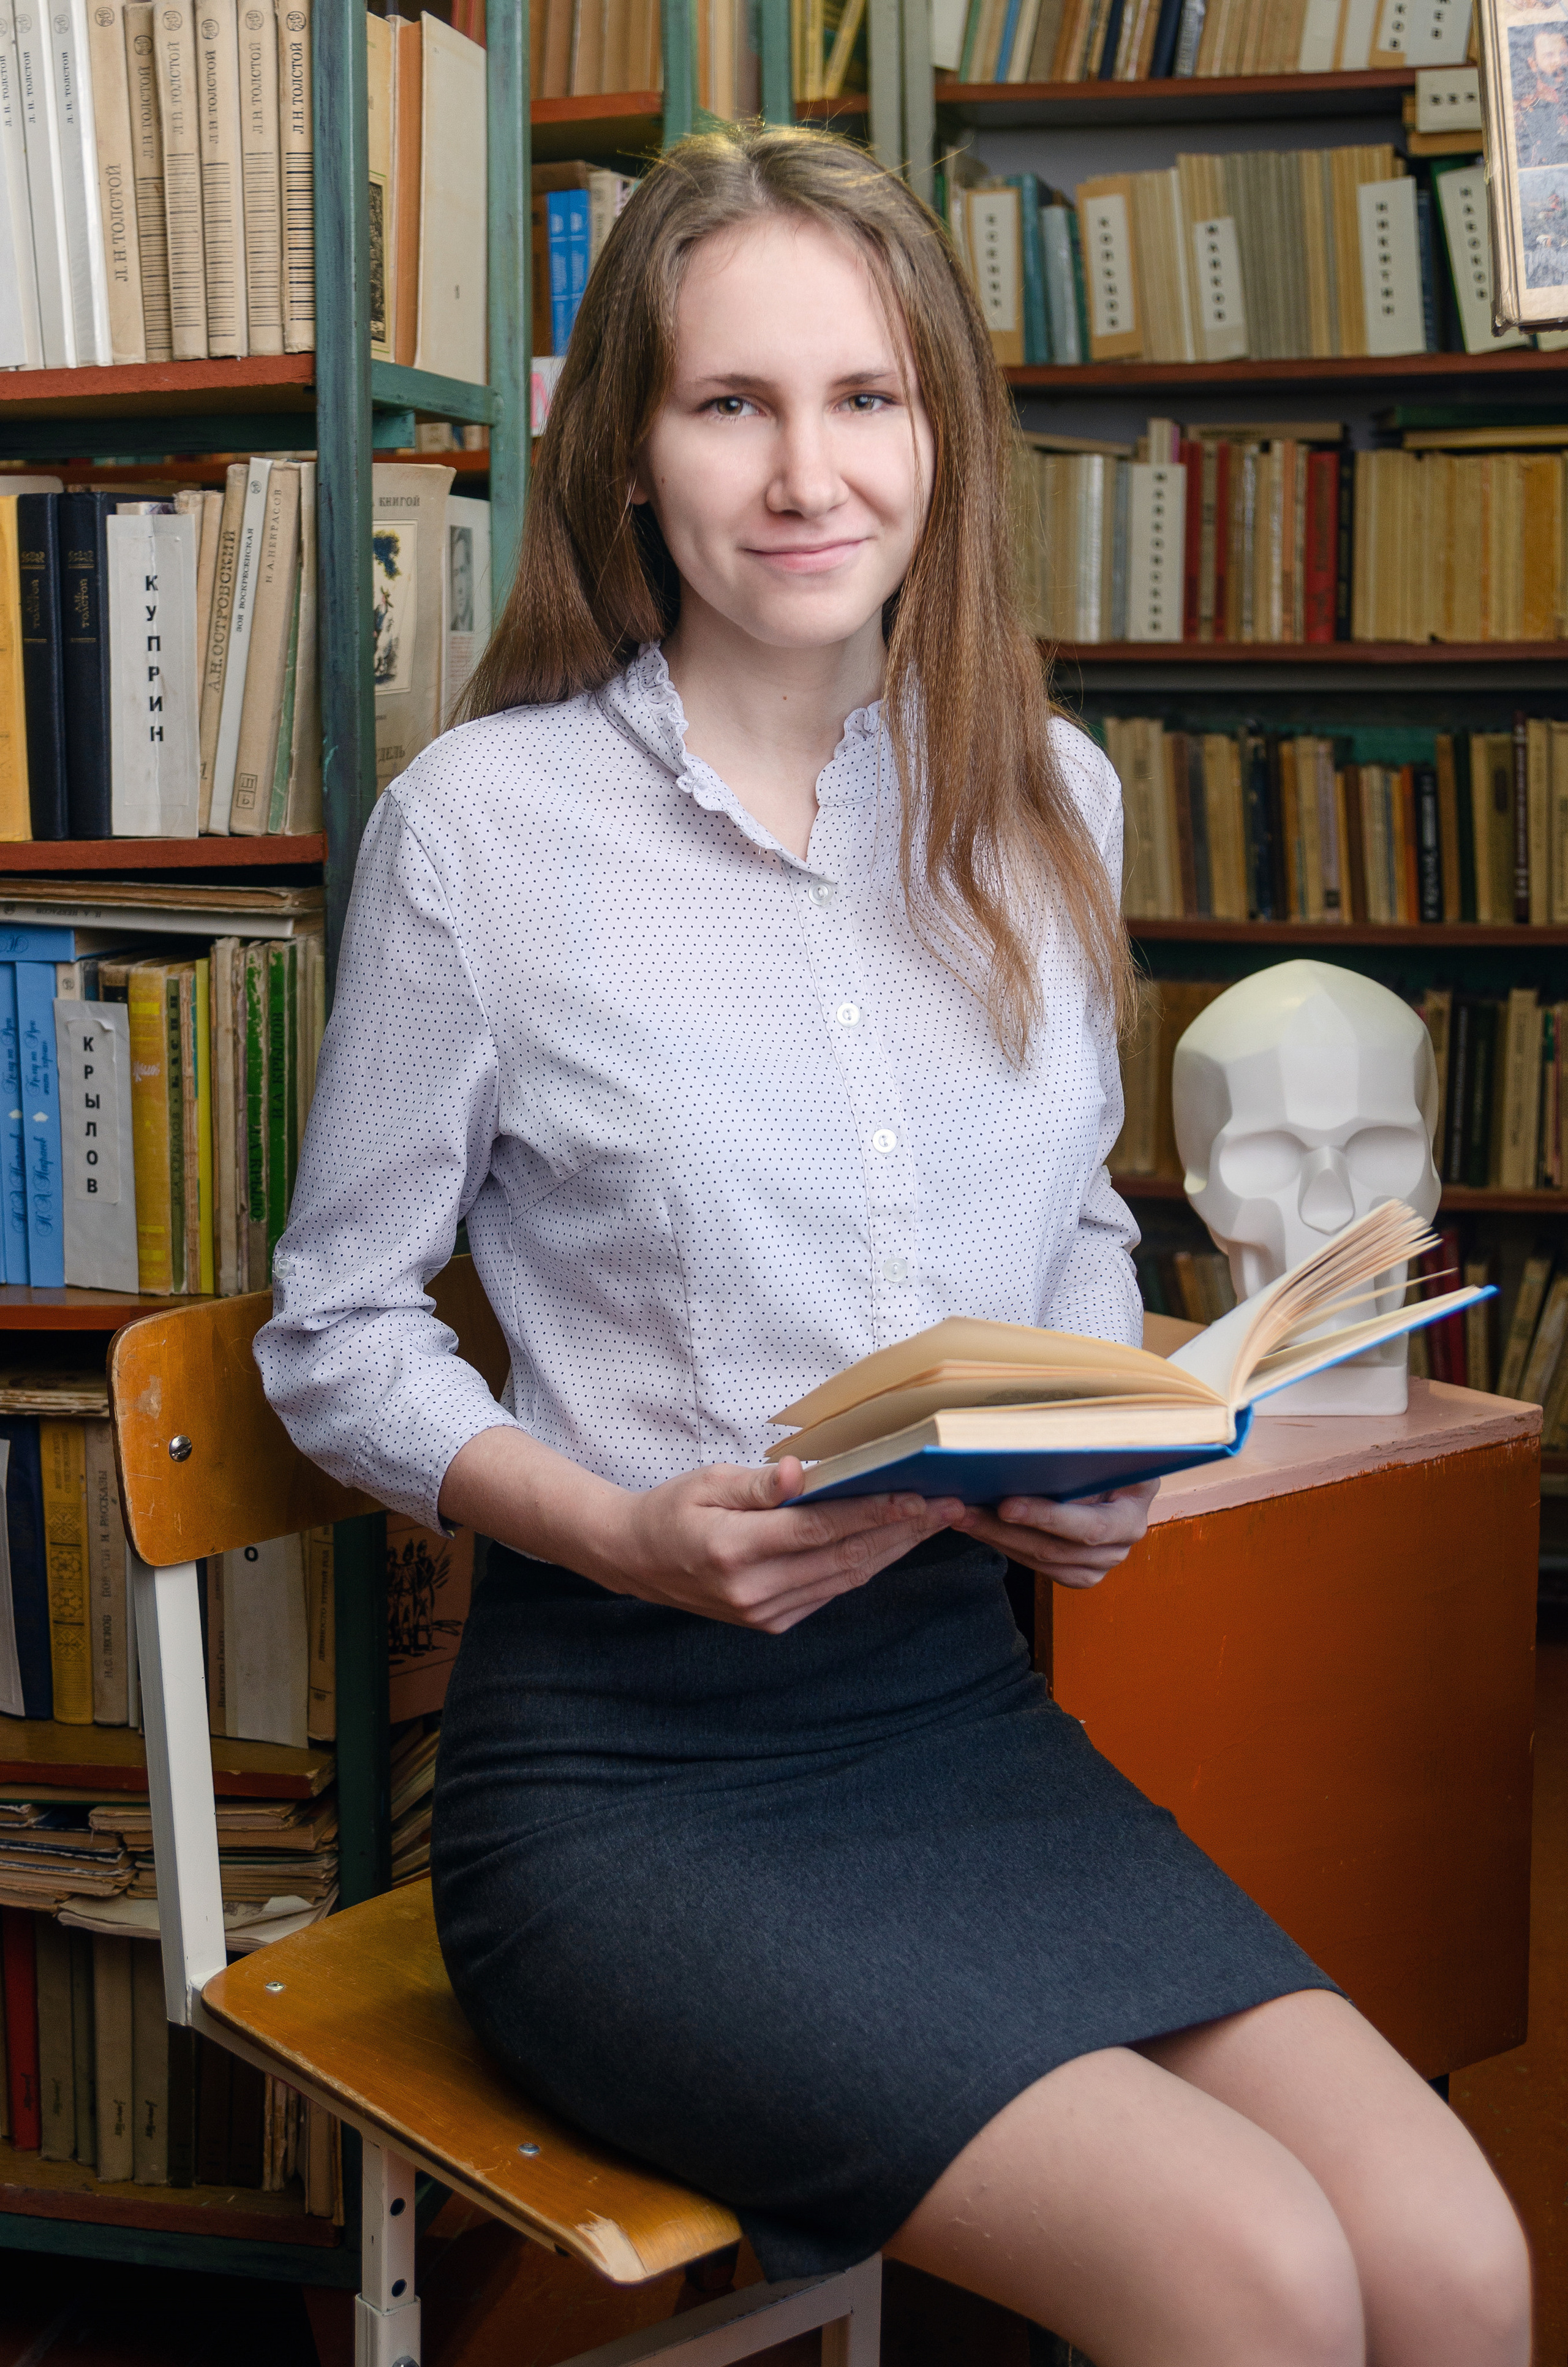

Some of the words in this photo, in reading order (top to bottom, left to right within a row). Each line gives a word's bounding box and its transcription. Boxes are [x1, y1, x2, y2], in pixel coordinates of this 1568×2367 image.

[23, 51, 33, 97] ТОЛСТОЙ
[62, 51, 71, 97] ТОЛСТОЙ
[138, 65, 153, 130] ТОЛСТОЙ
[167, 41, 183, 107] ТОЛСТОЙ
[205, 50, 217, 116] ТОЛСТОЙ
[249, 42, 263, 106] ТОЛСТОЙ
[290, 42, 304, 105] ТОЛСТОЙ
[105, 163, 125, 244] ТОЛСТОЙ
[268, 489, 282, 559] НЕКРАСОВ
[379, 495, 420, 507] КНИГОЙ
[213, 530, 236, 655] ОСТРОВСКИЙ
[239, 528, 254, 610] ВОСКРЕСЕНСКАЯ
[145, 575, 165, 742] КУПРИН
[271, 1012, 284, 1084] КРЫЛОВ
[83, 1035, 100, 1194] КРЫЛОВ
[98, 1470, 109, 1527] РАССКАЗЫ
